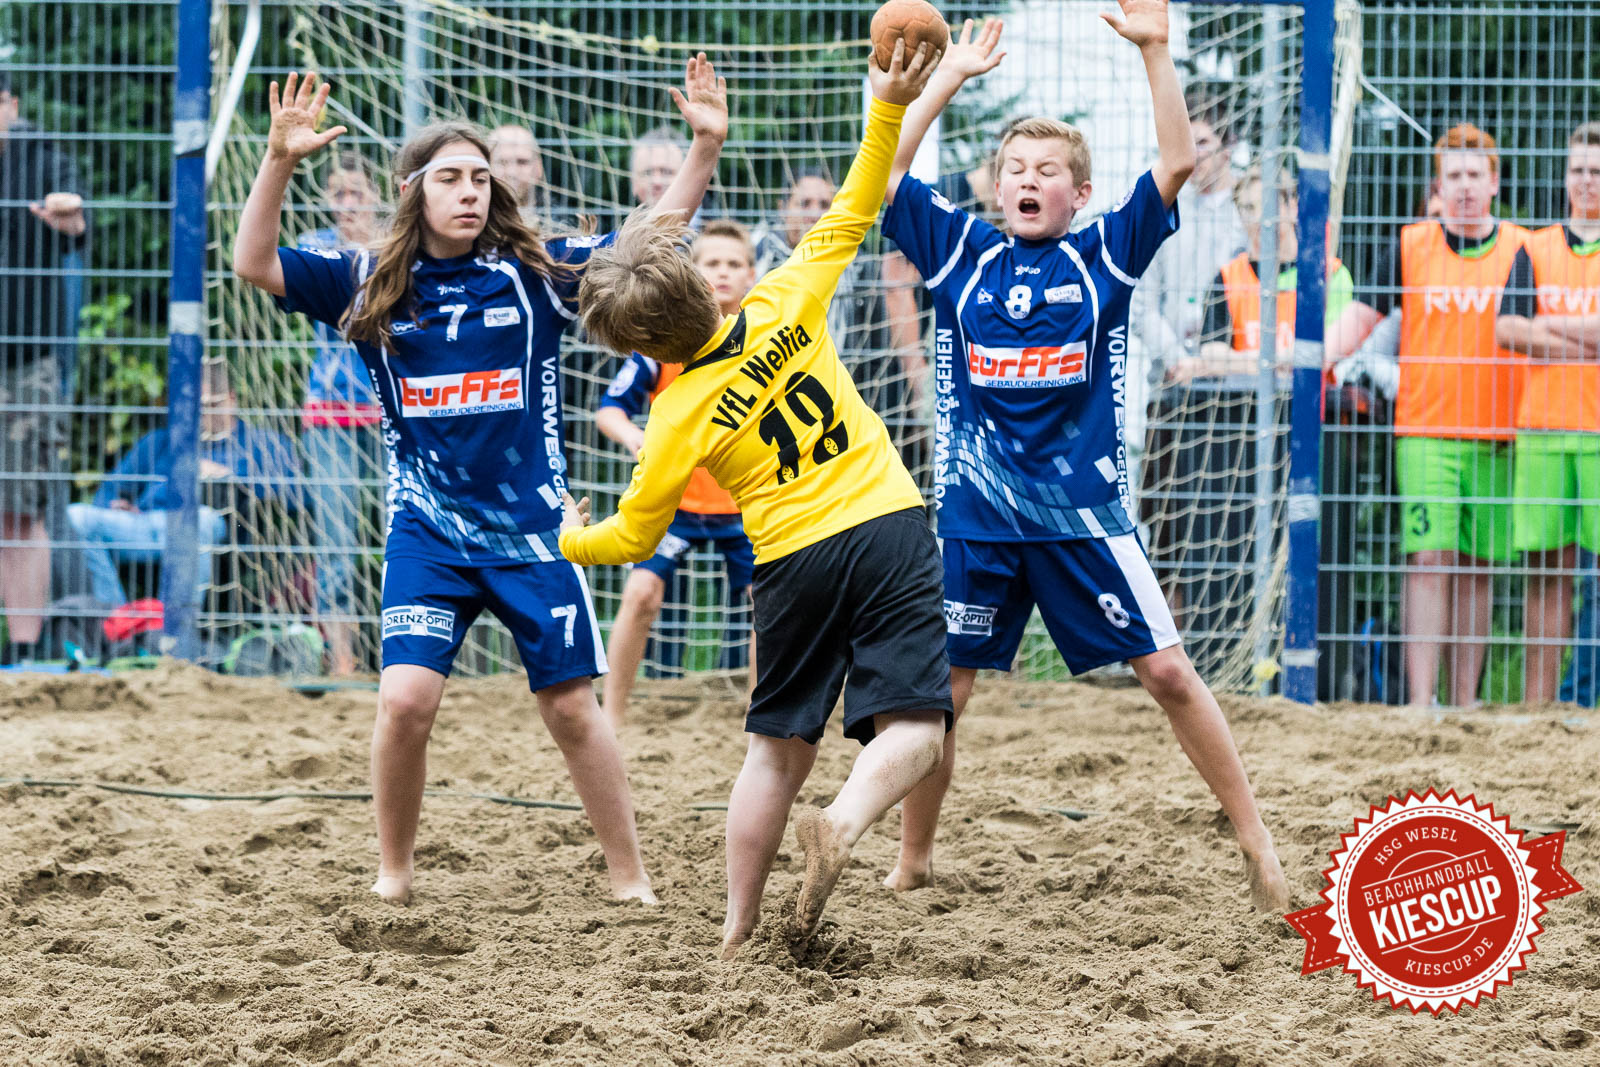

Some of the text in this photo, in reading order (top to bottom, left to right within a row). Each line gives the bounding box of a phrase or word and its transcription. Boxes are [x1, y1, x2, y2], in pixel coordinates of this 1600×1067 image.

[1005, 284, 1032, 320] 8
[1538, 285, 1600, 315] RW
[438, 304, 468, 341] 7
[711, 324, 812, 431] VfL Welfia
[936, 328, 953, 395] GEHEN
[984, 374, 1084, 388] GEBÄUDEREINIGUNG
[428, 402, 521, 417] GEBÄUDEREINIGUNG
[541, 357, 562, 470] VORWEG
[759, 371, 849, 486] 12
[1409, 502, 1431, 536] 3
[551, 604, 578, 648] 7
[1098, 592, 1131, 629] 8
